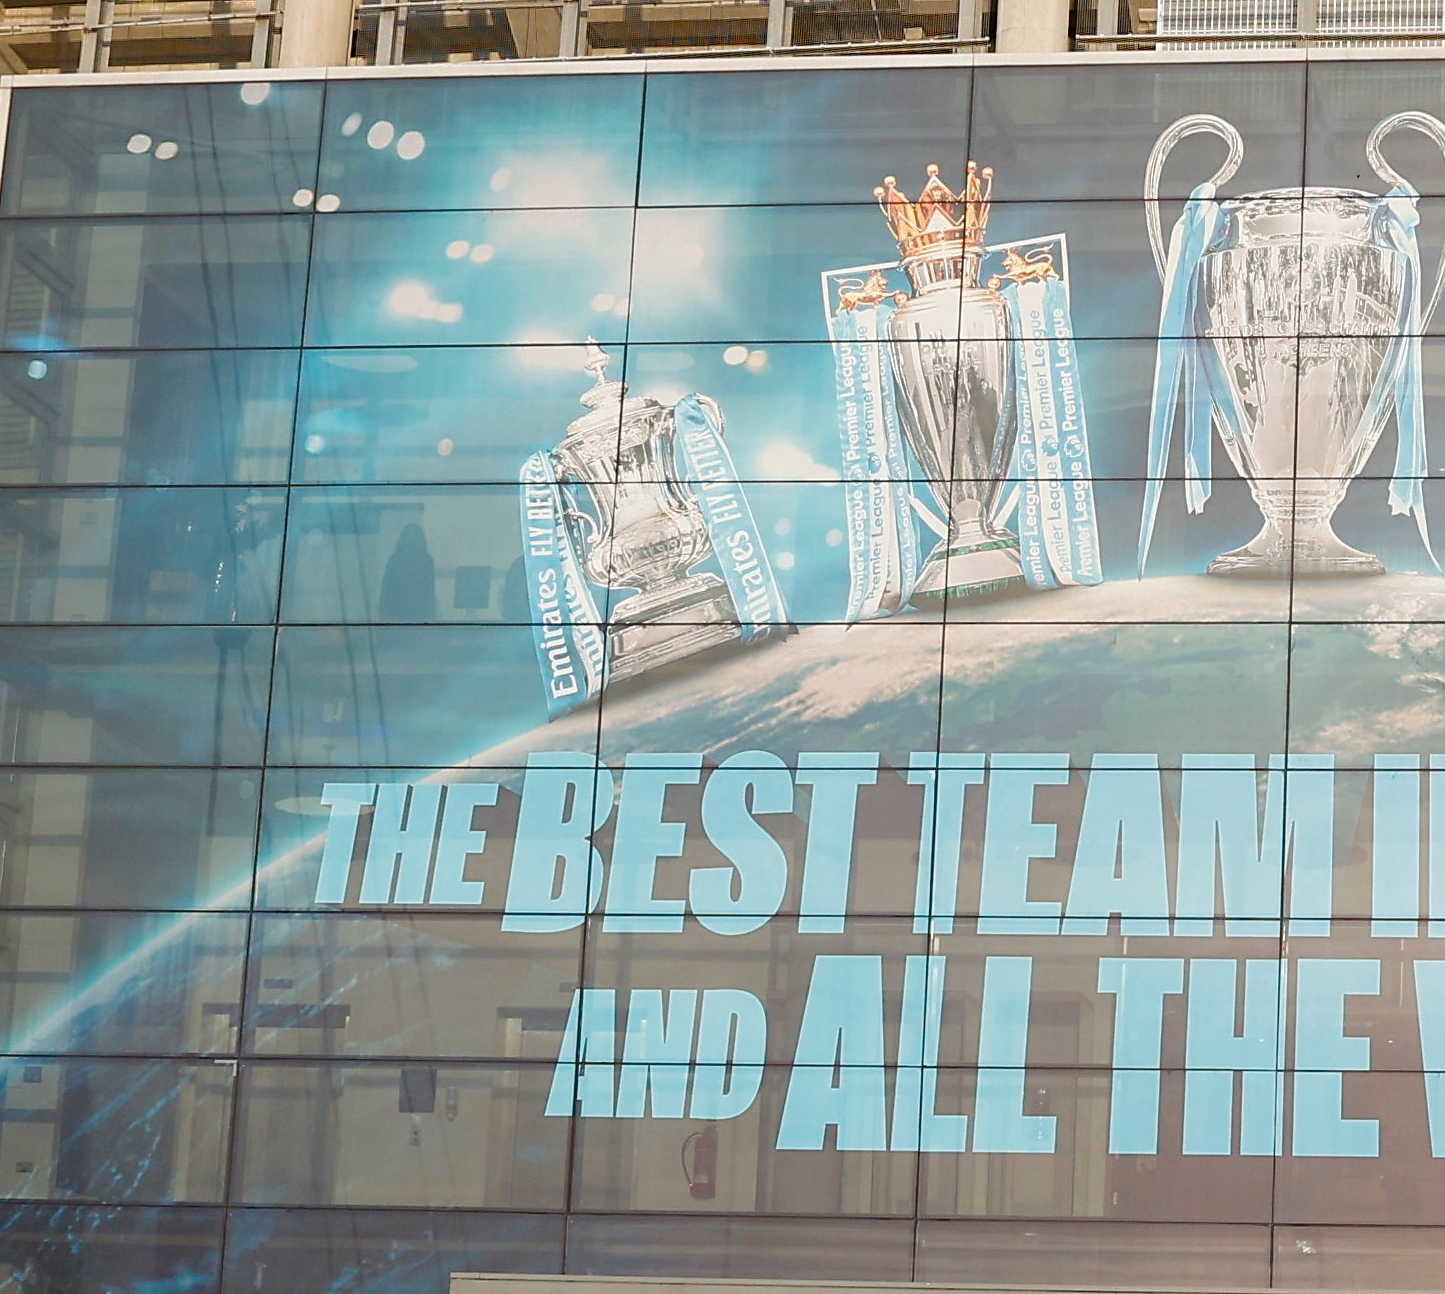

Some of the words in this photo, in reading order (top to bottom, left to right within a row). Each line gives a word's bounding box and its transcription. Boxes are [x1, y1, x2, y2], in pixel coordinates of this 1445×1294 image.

[1056, 308, 1076, 366] League
[1062, 369, 1078, 431] Premier
[529, 521, 553, 556] FLY
[539, 568, 578, 698] Emirates
[312, 781, 494, 908] THE
[501, 750, 875, 935] BEST
[906, 753, 1331, 937] TEAM
[545, 984, 769, 1121] AND
[772, 953, 1059, 1155] ALL
[1099, 956, 1381, 1159] THE
